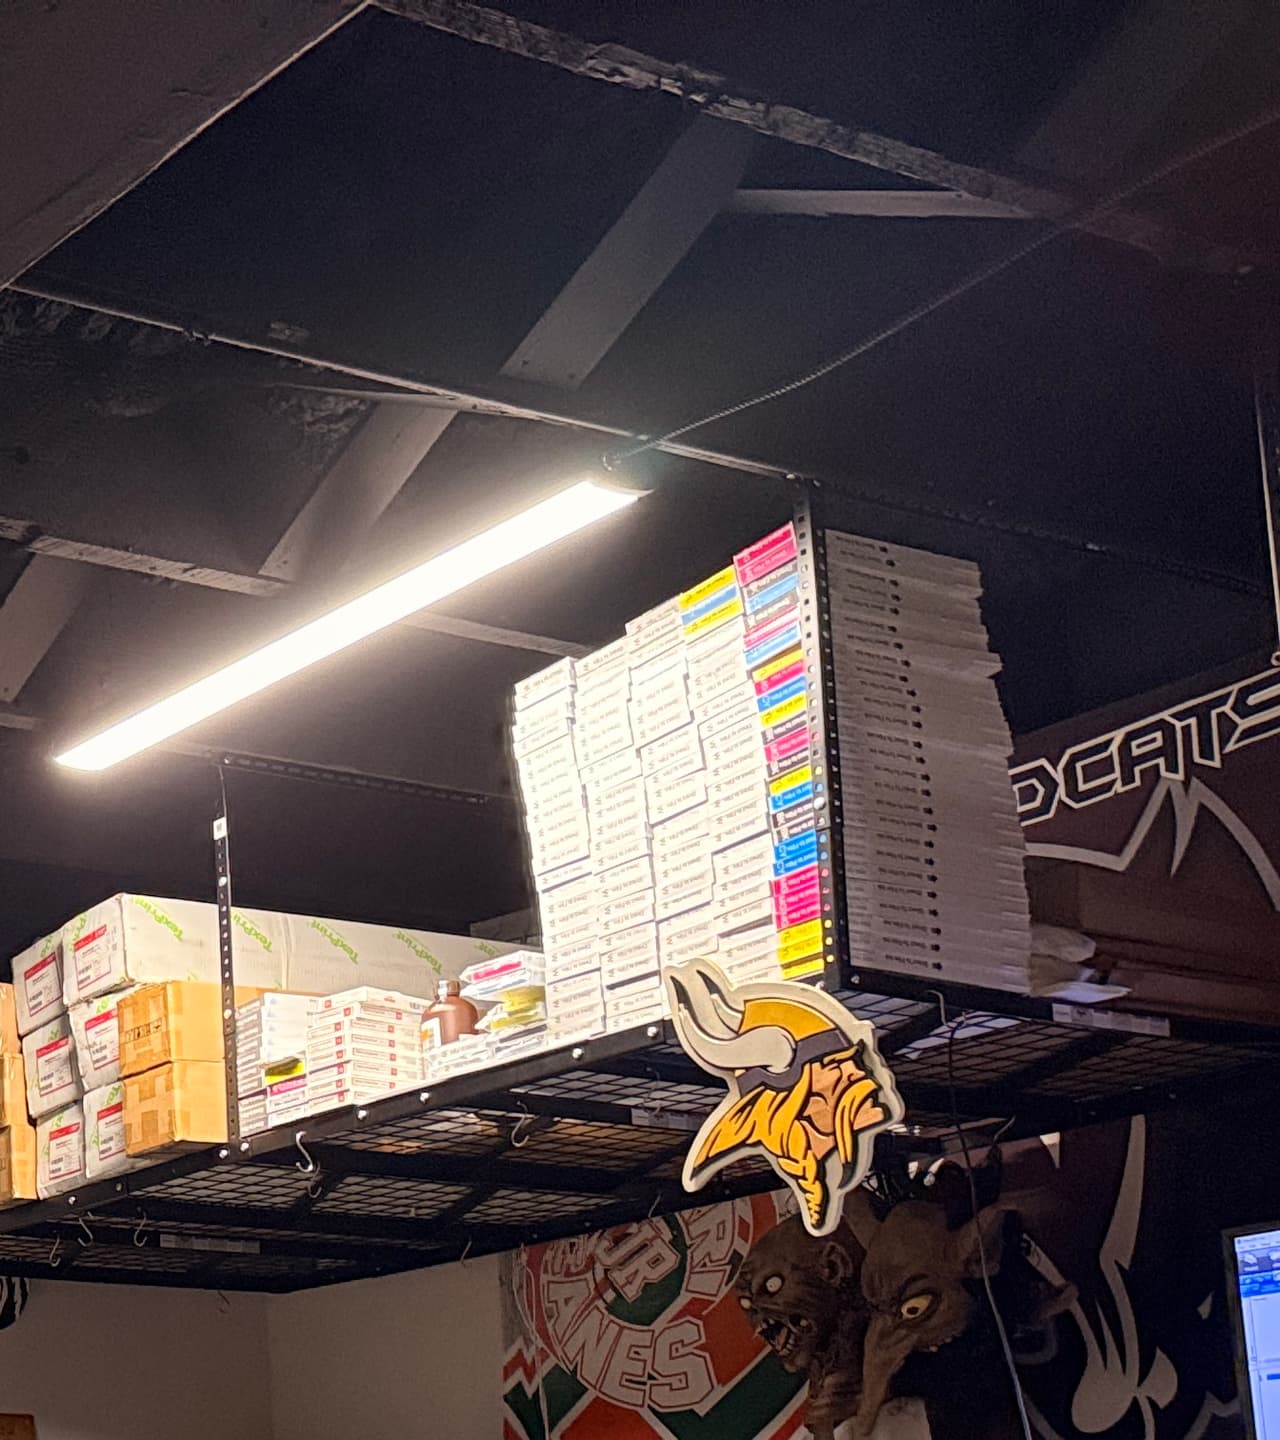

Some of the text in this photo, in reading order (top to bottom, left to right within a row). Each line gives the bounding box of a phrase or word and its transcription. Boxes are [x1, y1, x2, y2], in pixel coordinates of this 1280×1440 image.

[1008, 668, 1280, 828] DCATS
[232, 913, 272, 952] TexPri
[544, 1277, 717, 1413] ANES
